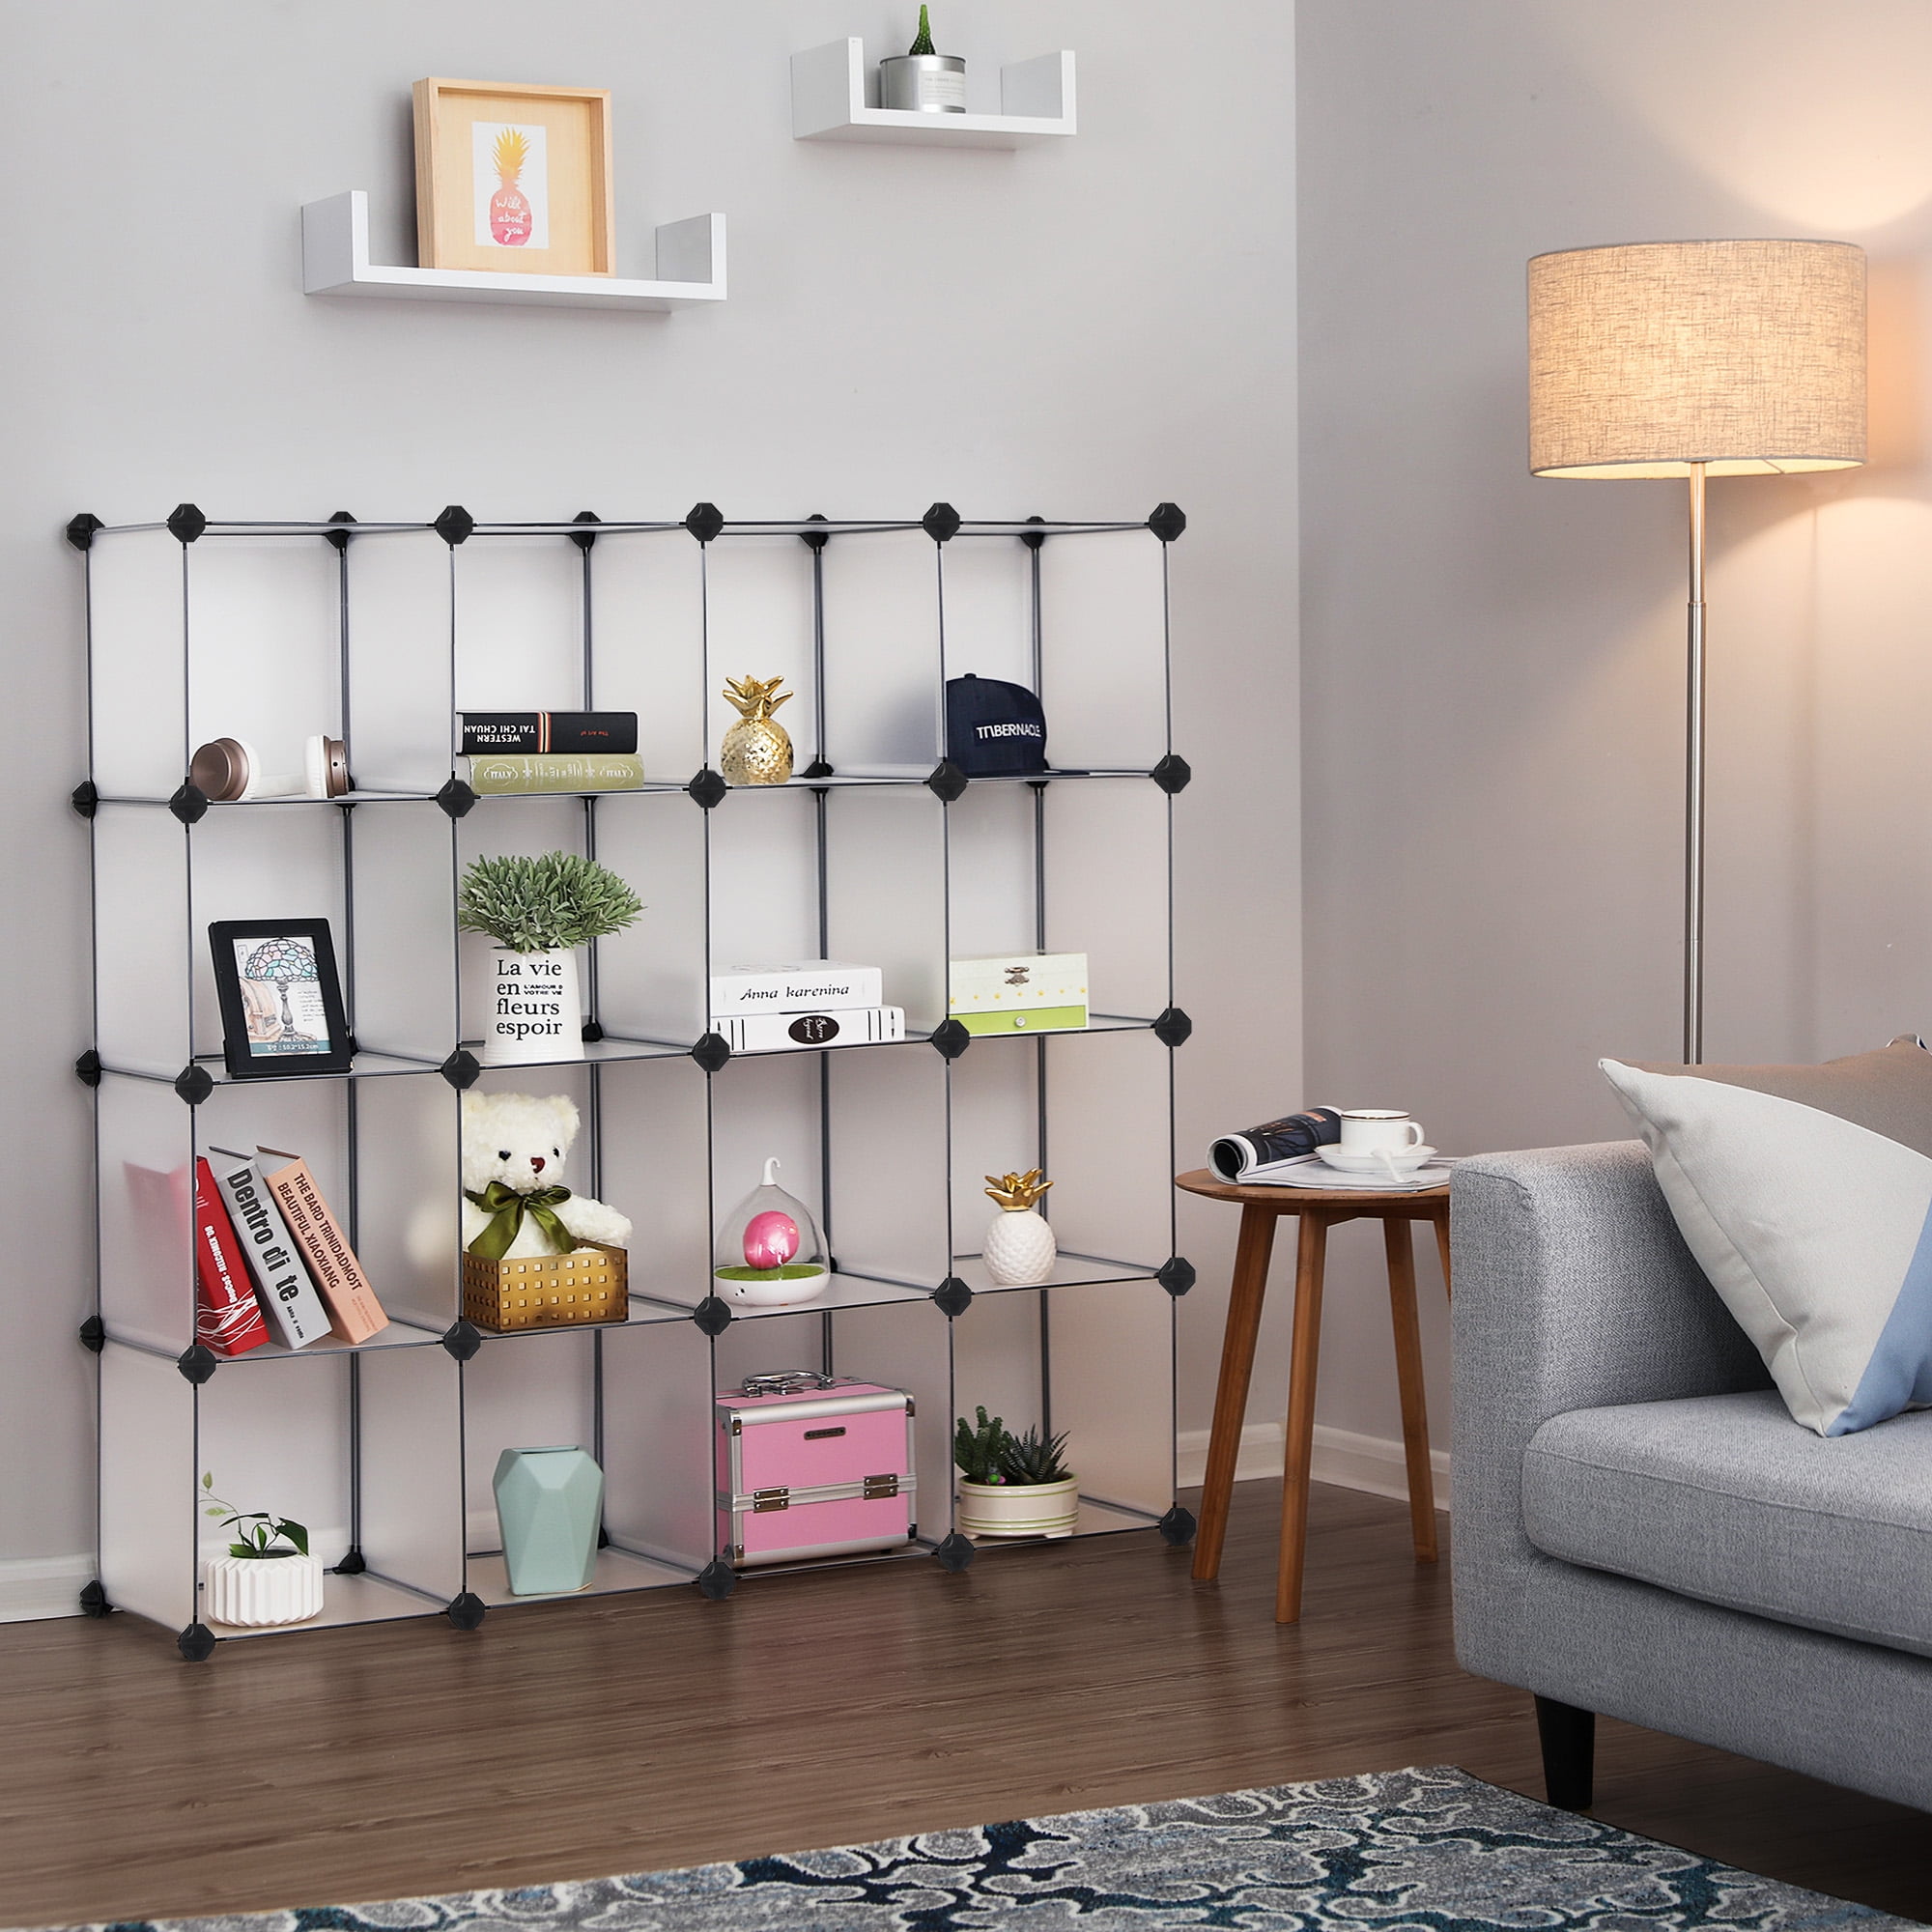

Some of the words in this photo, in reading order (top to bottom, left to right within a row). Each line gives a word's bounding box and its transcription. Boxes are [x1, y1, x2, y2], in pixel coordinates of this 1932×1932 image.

[504, 227, 525, 242] you
[464, 724, 497, 734] CHUAN
[499, 724, 517, 734] CHI
[520, 724, 536, 734] TAI
[476, 734, 522, 743] WESTERN
[497, 959, 522, 976] La
[529, 959, 562, 976] vie
[497, 982, 521, 995] en
[739, 987, 779, 1001] Anna
[785, 983, 850, 999] karenina
[497, 998, 560, 1015] fleurs
[496, 1019, 562, 1040] espoir
[227, 1168, 274, 1245] Dentro
[277, 1182, 312, 1236] BEAUTIFUL
[304, 1234, 340, 1289] XIAOXIANG
[294, 1173, 311, 1195] THE
[303, 1191, 326, 1222] BARD
[319, 1218, 363, 1291] TRINIDADMOST
[262, 1246, 291, 1272] di
[275, 1274, 299, 1302] te
